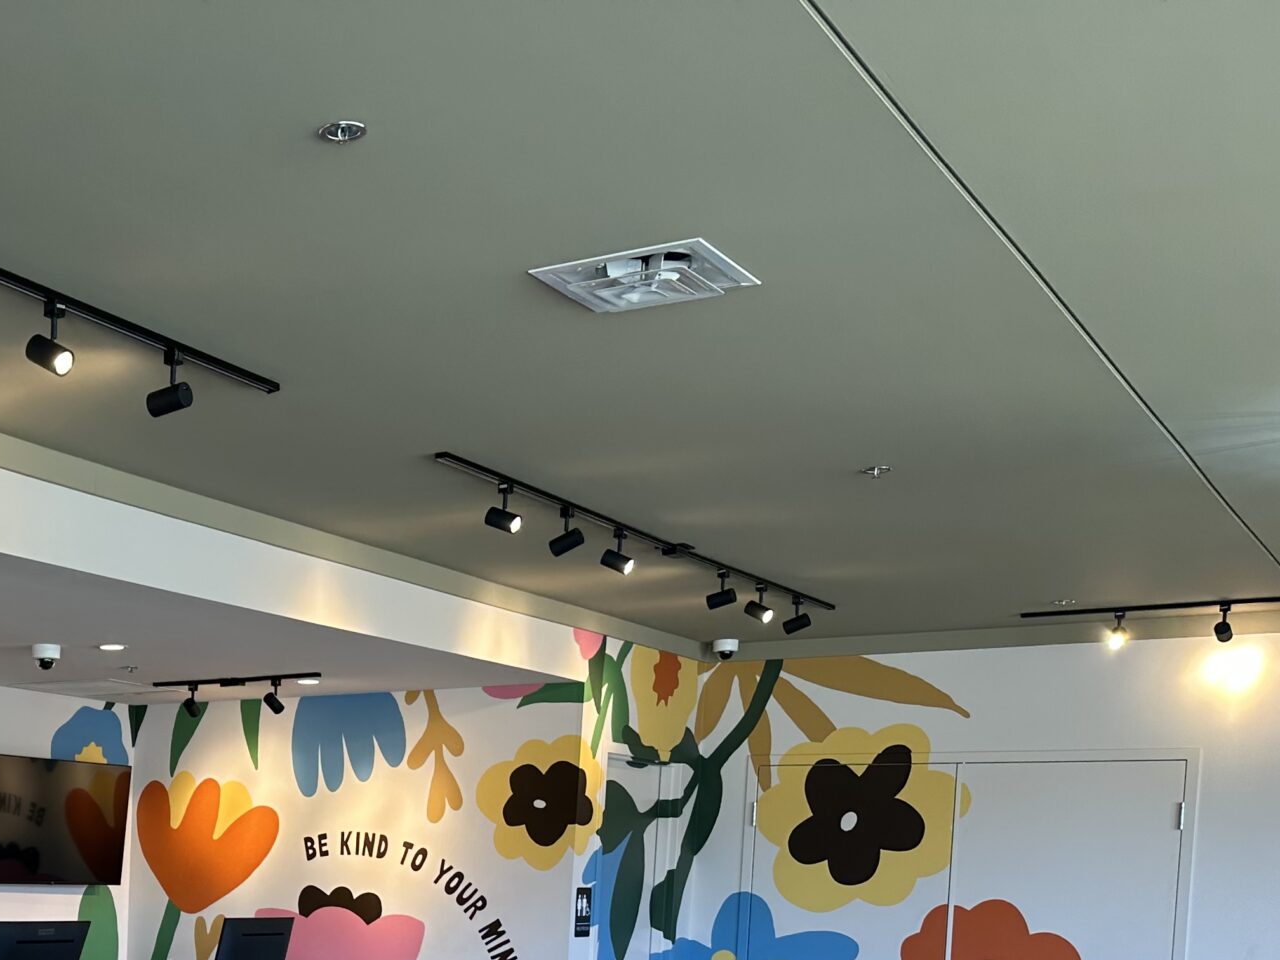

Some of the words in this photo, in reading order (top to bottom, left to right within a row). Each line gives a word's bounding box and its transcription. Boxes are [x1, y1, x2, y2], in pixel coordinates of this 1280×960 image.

[303, 833, 329, 861] BE
[340, 831, 388, 859] KIND
[400, 841, 428, 872] TO
[433, 859, 488, 921] YOUR
